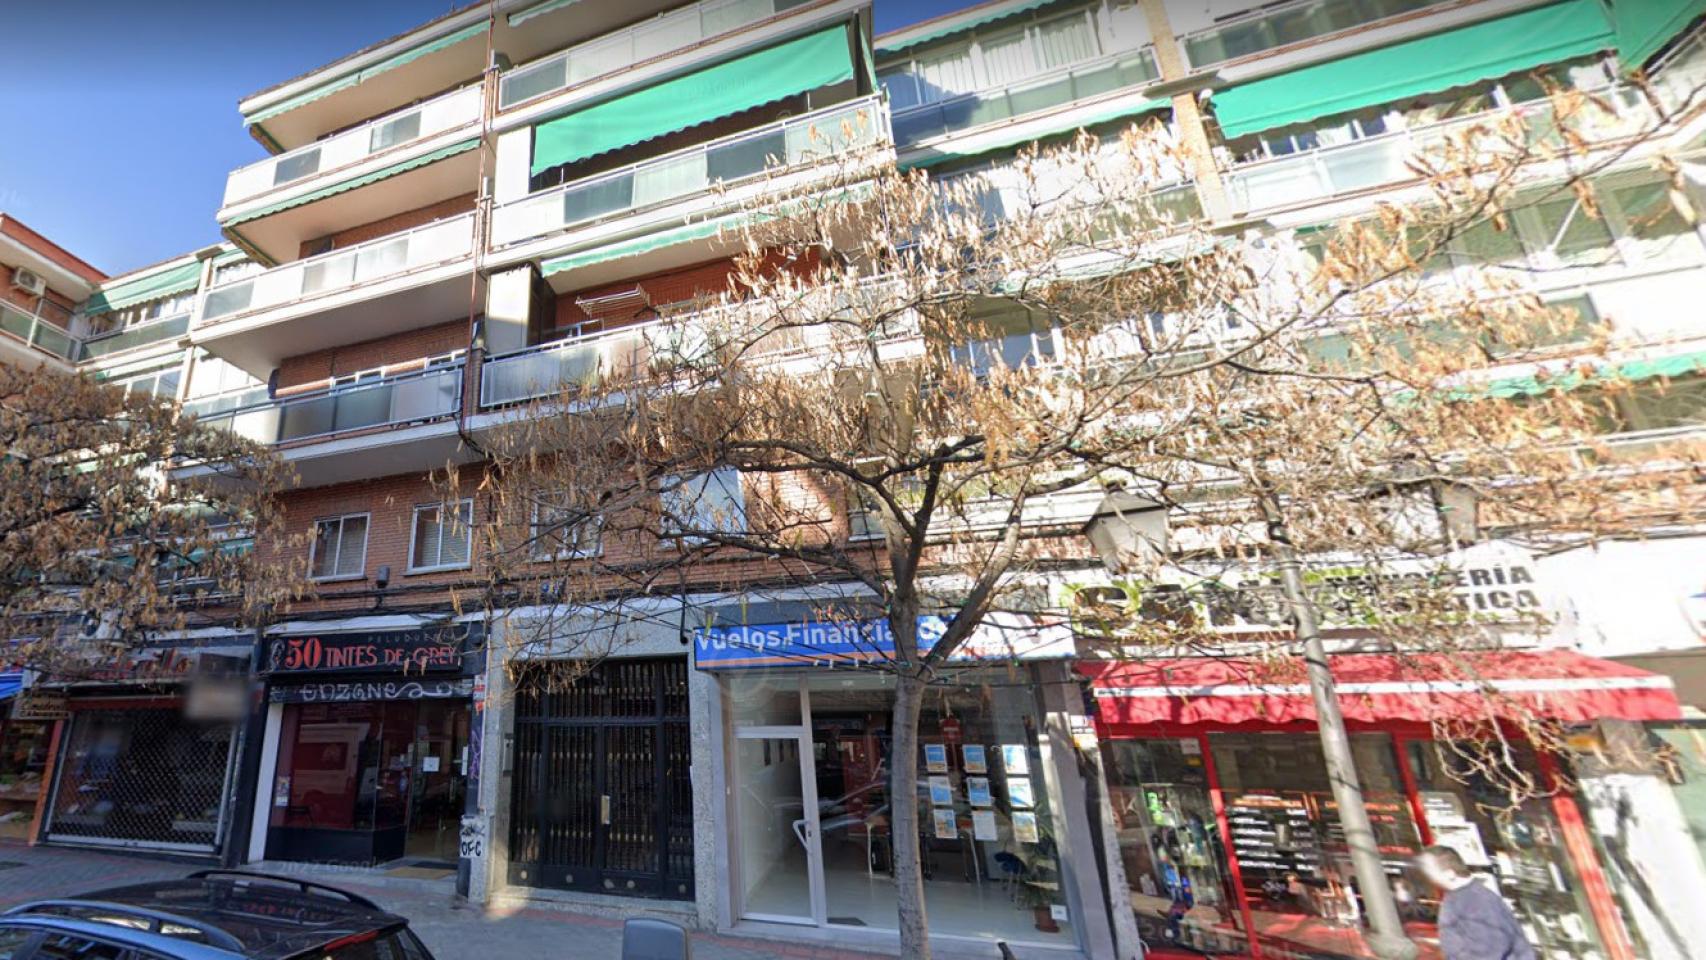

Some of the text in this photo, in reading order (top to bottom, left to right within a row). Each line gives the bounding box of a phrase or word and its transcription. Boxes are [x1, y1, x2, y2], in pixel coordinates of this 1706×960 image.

[694, 626, 780, 650] Vuelos
[285, 637, 322, 669] 50
[324, 645, 378, 667] TINTES
[384, 648, 405, 665] DE
